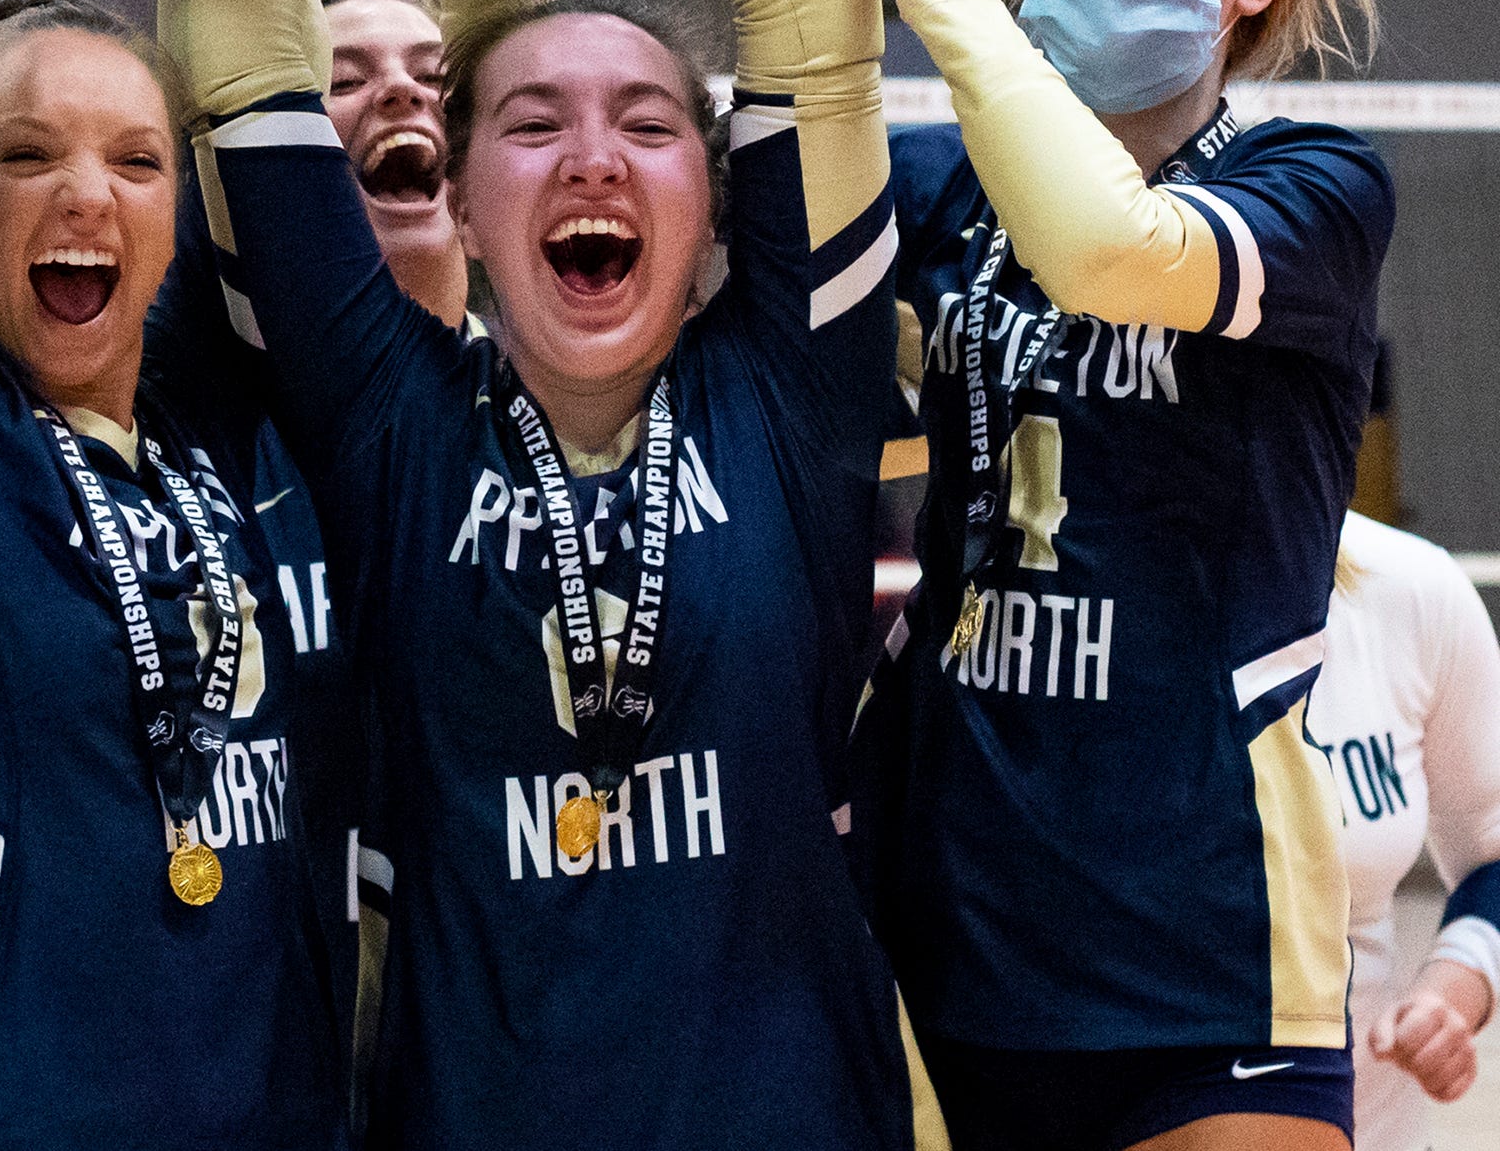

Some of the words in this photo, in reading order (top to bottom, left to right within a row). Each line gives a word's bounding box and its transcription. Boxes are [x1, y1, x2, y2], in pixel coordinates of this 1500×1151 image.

[75, 470, 164, 692] CHAMPIONSHIPS
[508, 395, 550, 456] STATE
[533, 453, 596, 665] CHAMPIONSHIPS
[203, 616, 239, 711] STATE
[626, 571, 663, 666] STATE
[505, 749, 725, 880] NORTH
